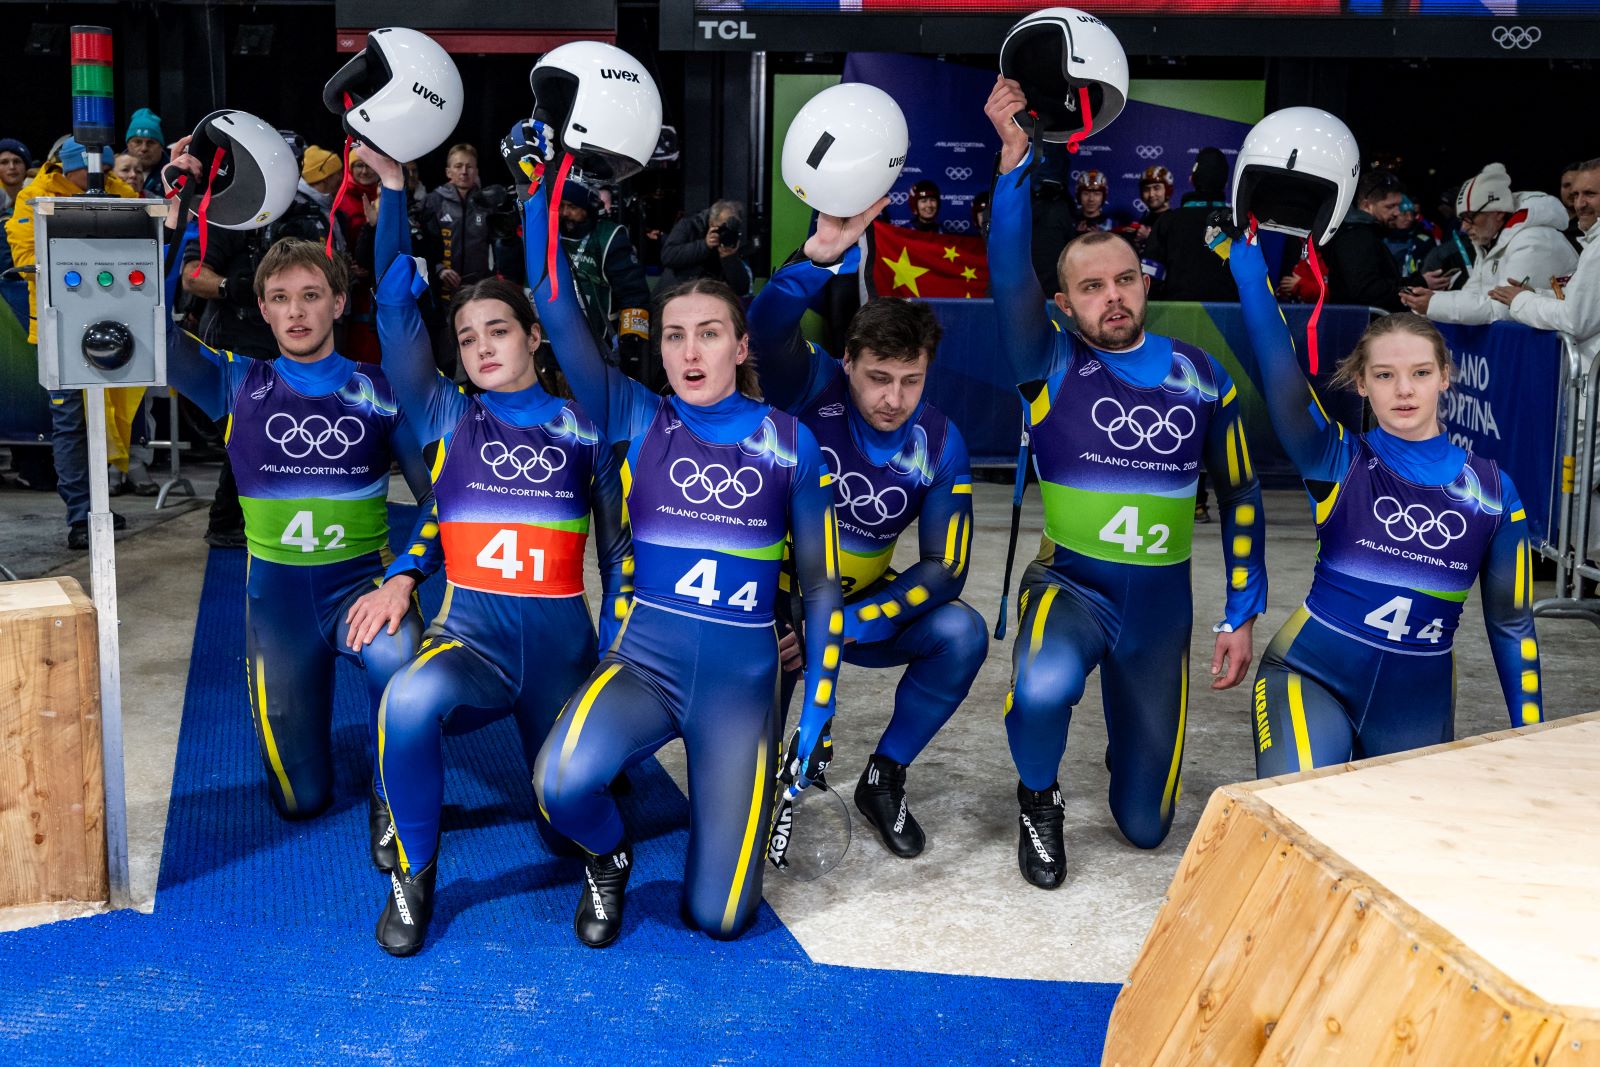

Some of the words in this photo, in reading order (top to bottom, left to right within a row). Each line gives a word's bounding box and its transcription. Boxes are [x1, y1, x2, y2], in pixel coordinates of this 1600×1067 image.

[698, 20, 756, 40] TCL
[600, 68, 641, 84] uvex
[412, 81, 447, 110] uvex
[1450, 349, 1489, 391] LANO
[259, 464, 302, 474] MILANO
[303, 466, 350, 475] CORTINA
[351, 465, 370, 475] 2026
[1079, 452, 1130, 467] MILANO
[1131, 460, 1181, 472] CORTINA
[466, 482, 508, 494] MILANO
[510, 488, 554, 498] CORTINA
[555, 490, 574, 498] 2026
[281, 510, 320, 552] 4
[323, 524, 346, 550] 2
[656, 504, 698, 518] MILANO
[700, 512, 745, 526] CORTINA
[747, 518, 768, 526] 2026
[836, 520, 876, 538] ORTINA
[1099, 505, 1144, 553] 4
[1146, 524, 1170, 554] 2
[476, 528, 524, 579] 4
[528, 548, 544, 582] 1
[1356, 538, 1400, 556] MILANO
[1402, 550, 1448, 568] CORTINA
[1450, 561, 1468, 570] 2026
[674, 558, 720, 606] 4
[728, 582, 758, 612] 4
[1364, 596, 1413, 642] 4
[1416, 618, 1444, 644] 4
[1256, 678, 1272, 753] UKRAINE
[768, 807, 792, 864] uvex
